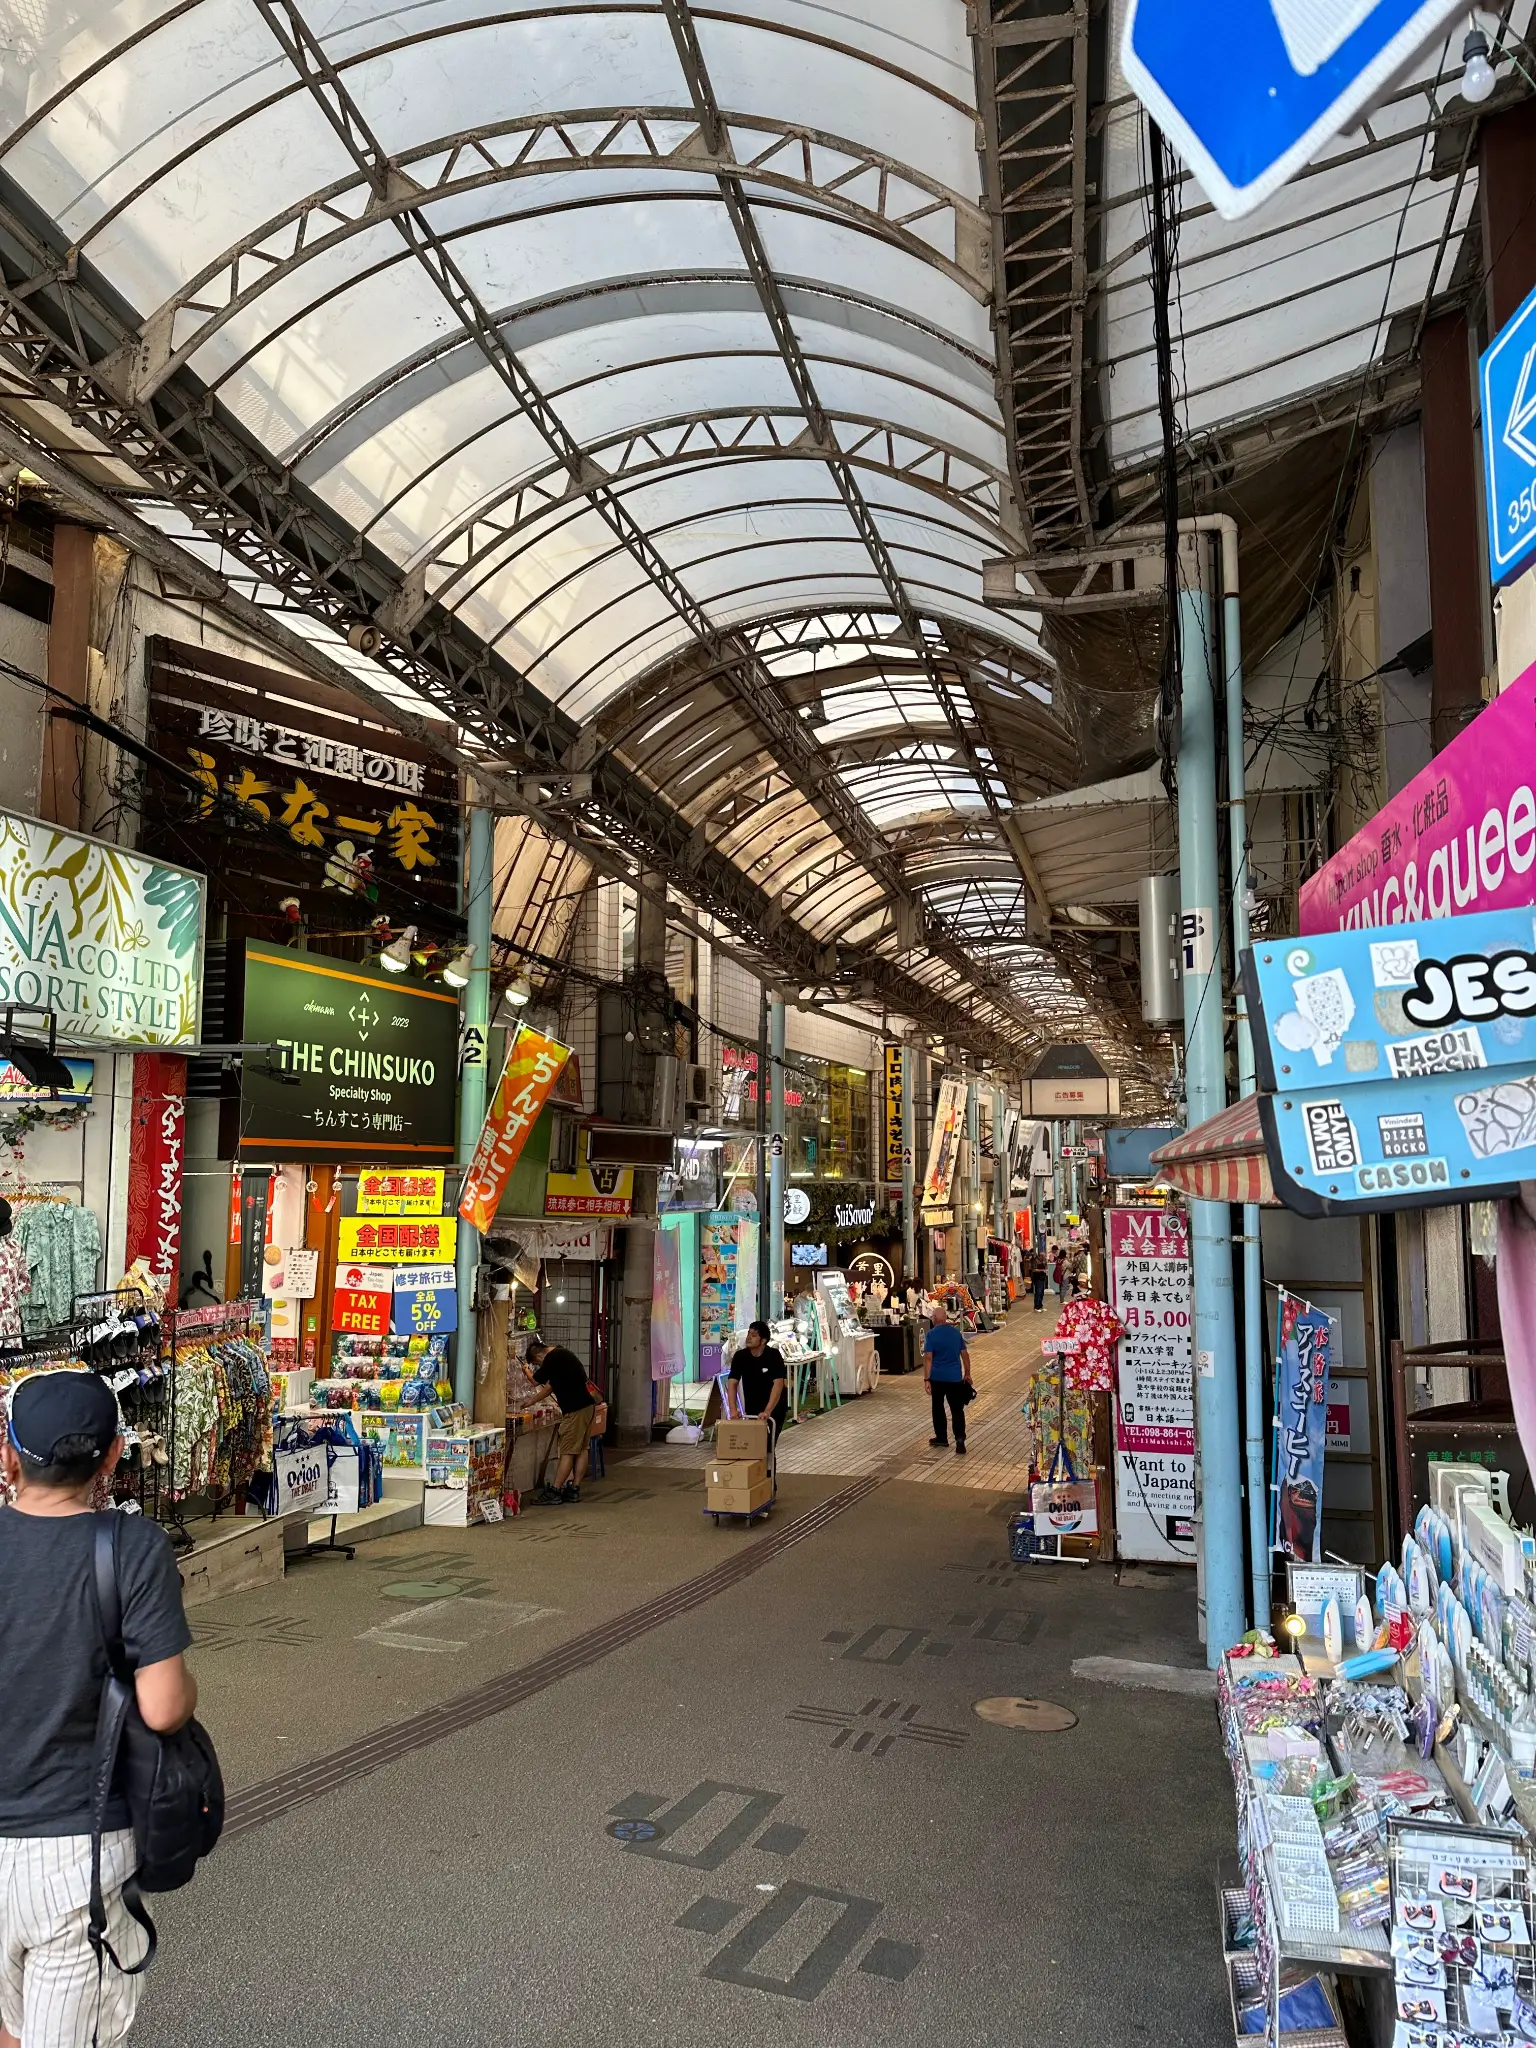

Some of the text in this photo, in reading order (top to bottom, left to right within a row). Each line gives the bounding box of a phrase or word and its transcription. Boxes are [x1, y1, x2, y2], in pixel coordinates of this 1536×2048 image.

[198, 709, 426, 792] 珍味と沖縄の味
[1357, 850, 1378, 882] shop
[97, 986, 177, 1030] STYLE
[304, 1000, 335, 1016] okinawa
[391, 1016, 410, 1028] 2023
[276, 1039, 435, 1086] THE CHINSUKO
[329, 1084, 392, 1104] Specialty Shop
[479, 1052, 558, 1201] ちんすこう
[1383, 1128, 1424, 1142] DIZER
[1385, 1142, 1426, 1155] ROCKO
[1359, 1161, 1446, 1190] CASON
[363, 1176, 436, 1196] 全国配送
[835, 1203, 872, 1228] SuiSavon
[356, 1224, 439, 1248] 全国配送
[1126, 1261, 1188, 1273] 外国人講師
[395, 1270, 454, 1287] 修学旅行生
[349, 1293, 377, 1309] TAX
[416, 1291, 435, 1302] 全品
[411, 1303, 441, 1321] 5%
[1124, 1306, 1191, 1329] 月5,00
[341, 1312, 380, 1331] FREE
[416, 1321, 436, 1331] OFF
[1132, 1333, 1183, 1344] プライベート
[1132, 1346, 1174, 1356] FAX学習
[1313, 1326, 1328, 1403] 本格派
[1286, 1323, 1313, 1478] アイスコーヒー
[1146, 1414, 1174, 1423] 日本語
[1122, 1455, 1186, 1473] Want to
[1427, 1451, 1496, 1463] 音楽と喫茶
[287, 1463, 320, 1489] Orion
[291, 1480, 318, 1499] THE DRAFT
[1127, 1490, 1147, 1499] Enjoy
[1151, 1491, 1180, 1500] meeting
